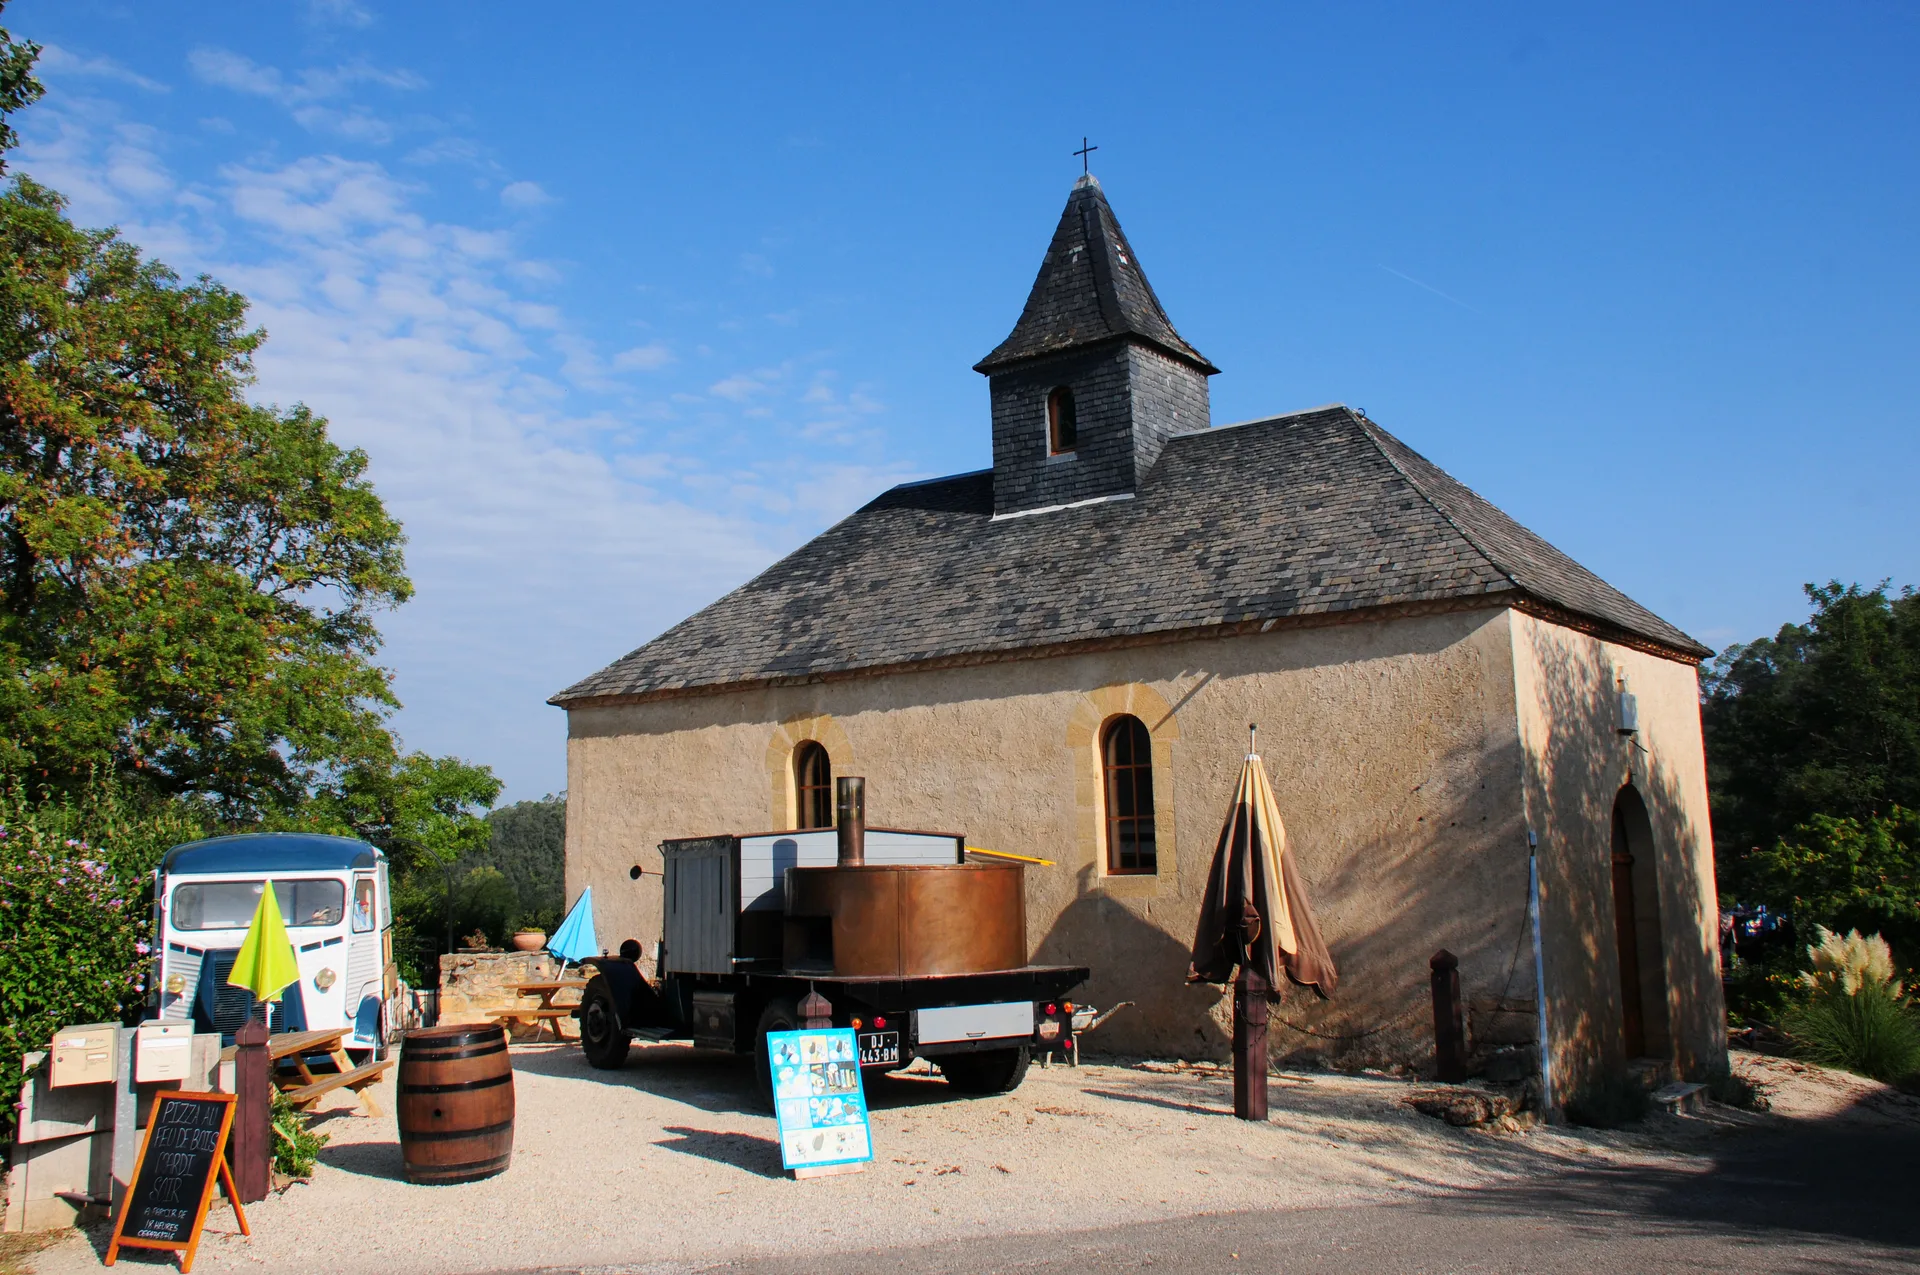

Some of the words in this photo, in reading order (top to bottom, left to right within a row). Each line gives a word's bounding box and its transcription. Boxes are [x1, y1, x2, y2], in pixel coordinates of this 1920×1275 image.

[162, 1102, 200, 1124] PIZZA
[201, 1106, 219, 1125] AU
[153, 1125, 177, 1148] FEU
[175, 1127, 193, 1149] DE
[189, 1129, 219, 1152] BOIS
[154, 1151, 197, 1177] MARDI
[149, 1176, 182, 1203] SOIR
[152, 1206, 178, 1218] PARTIR
[177, 1209, 188, 1219] DE
[154, 1221, 179, 1232] HEURES
